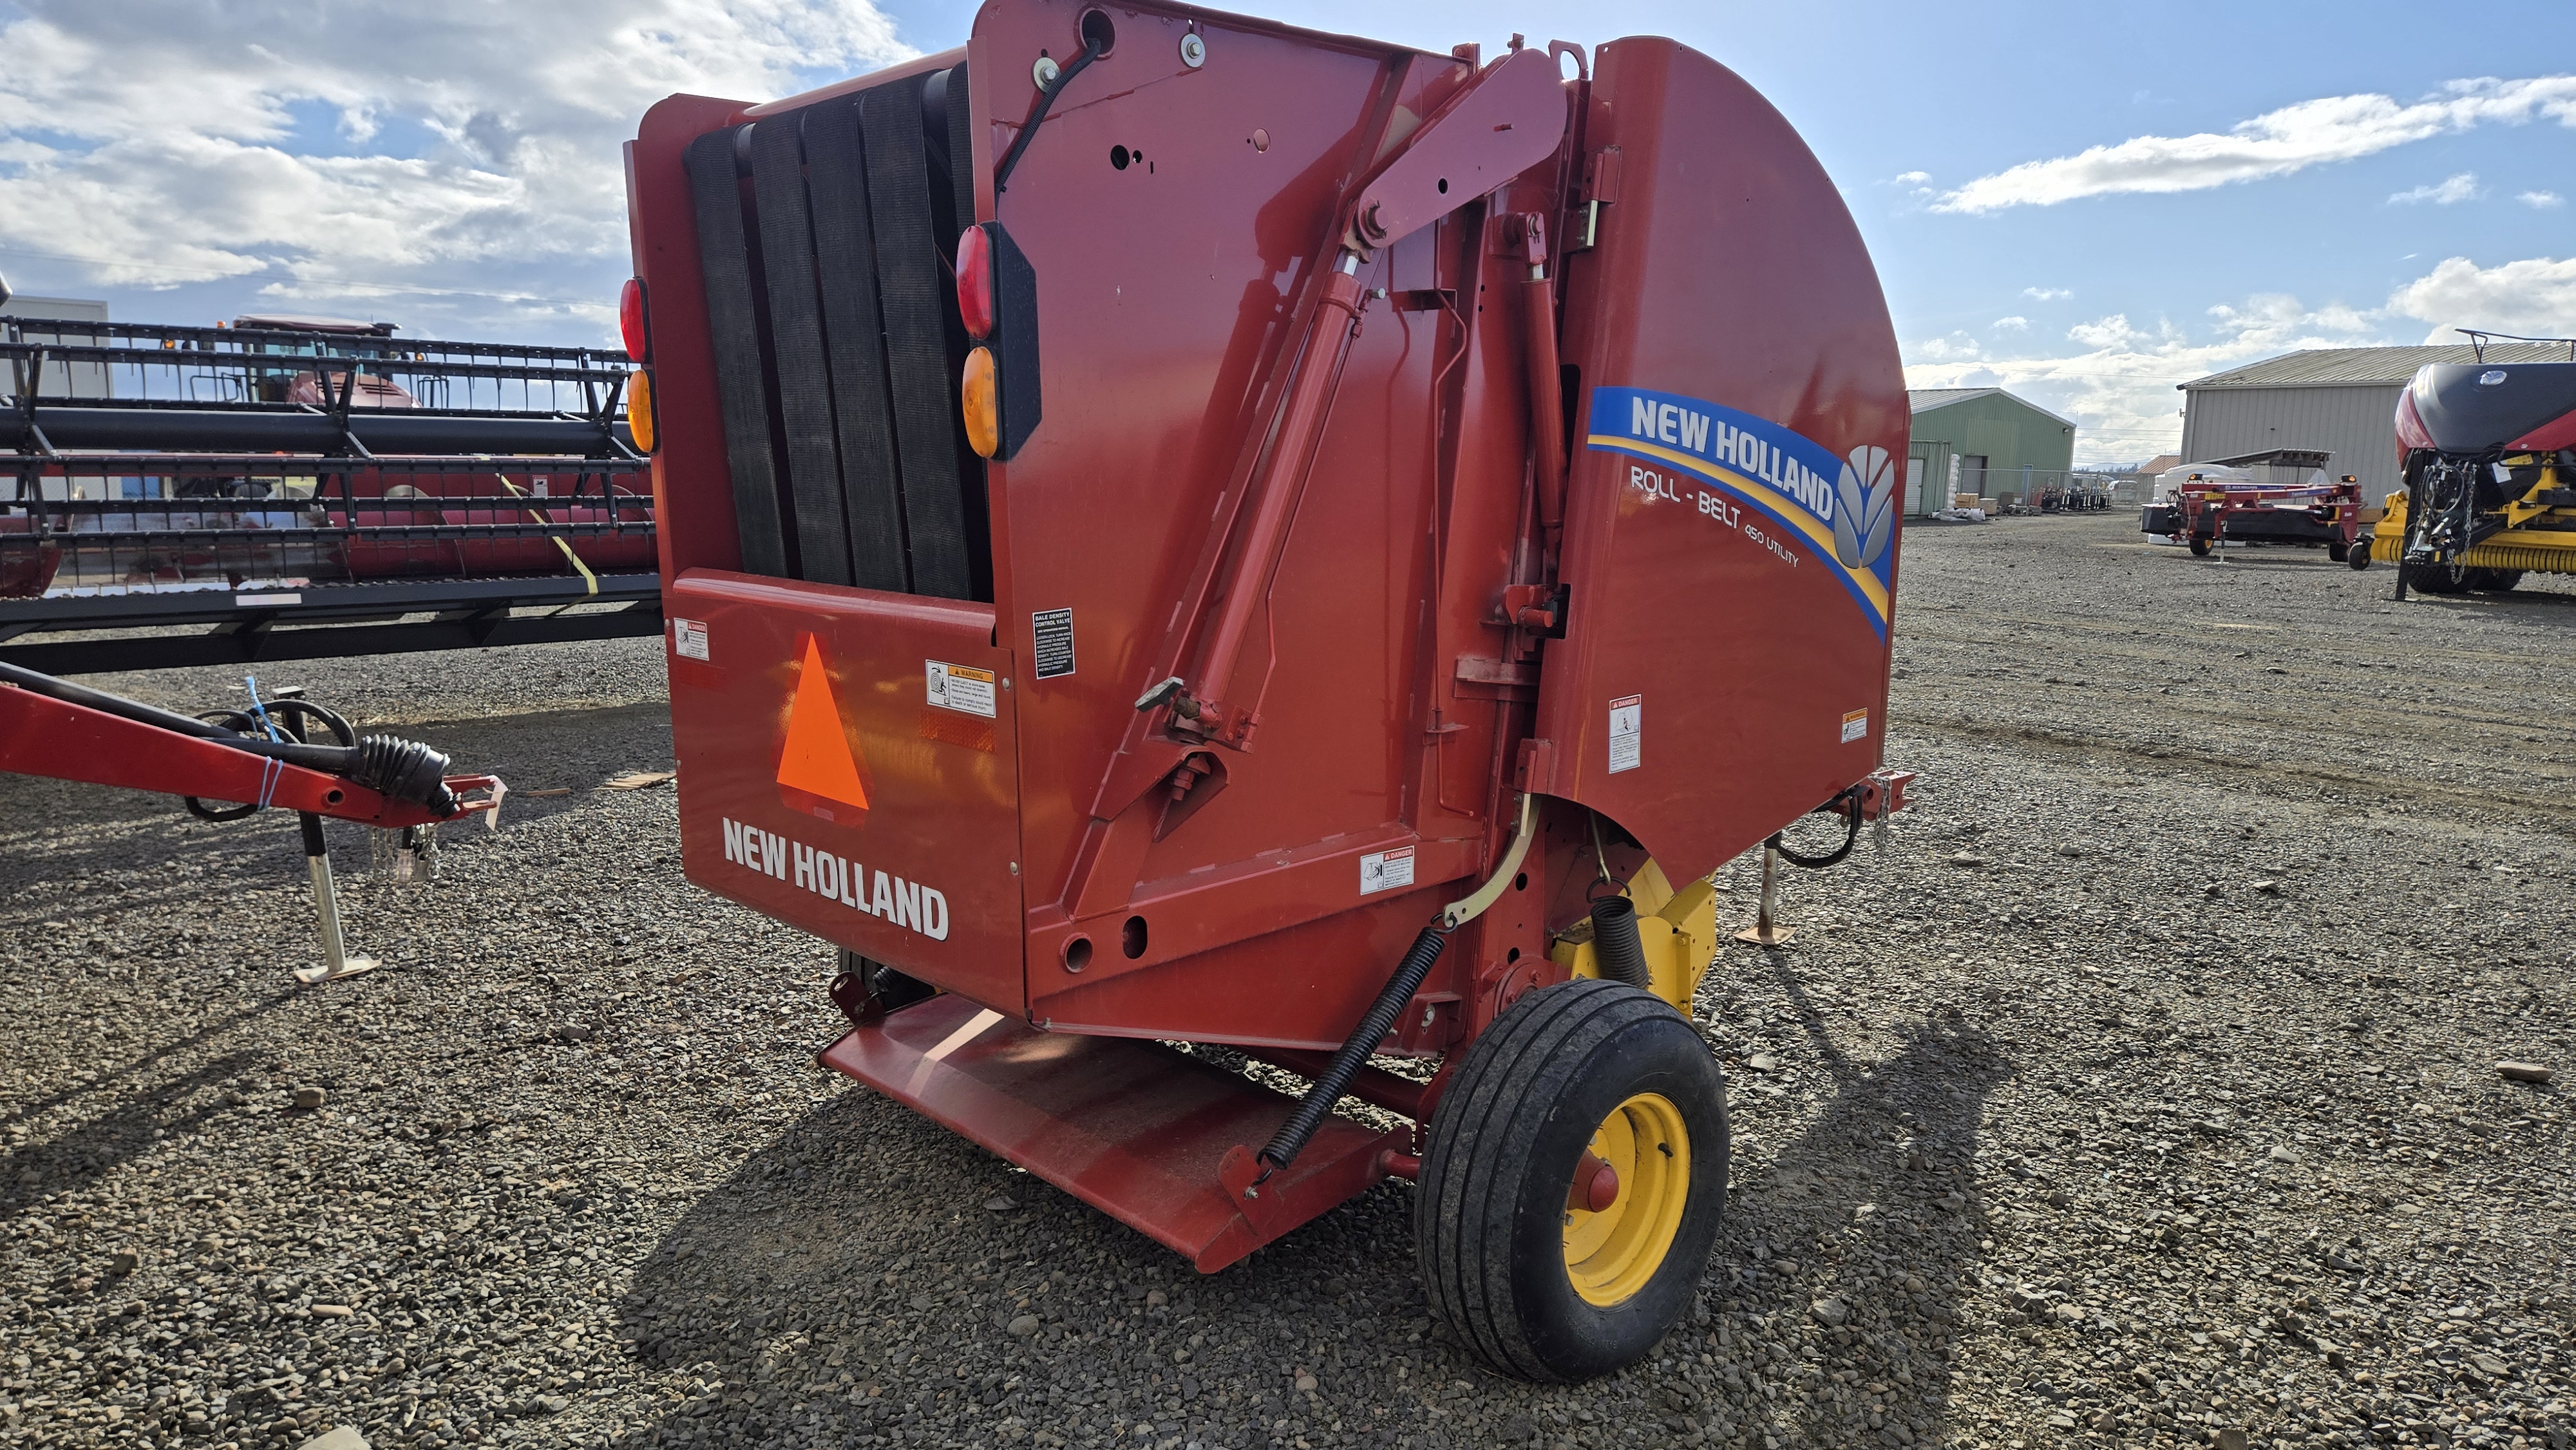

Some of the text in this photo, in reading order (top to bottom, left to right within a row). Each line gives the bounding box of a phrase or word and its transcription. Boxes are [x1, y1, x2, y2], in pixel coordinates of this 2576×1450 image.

[1631, 396, 1833, 521] NEW HOLLAND
[1631, 466, 1681, 503] ROLL
[1698, 491, 1741, 529] BELT
[1745, 524, 1765, 544] 450
[1766, 540, 1799, 568] UTILITY
[960, 669, 983, 679] WARNING
[1618, 698, 1638, 708] DANGER
[723, 817, 949, 941] NEW HOLLAND
[1390, 849, 1412, 859] DANGER
